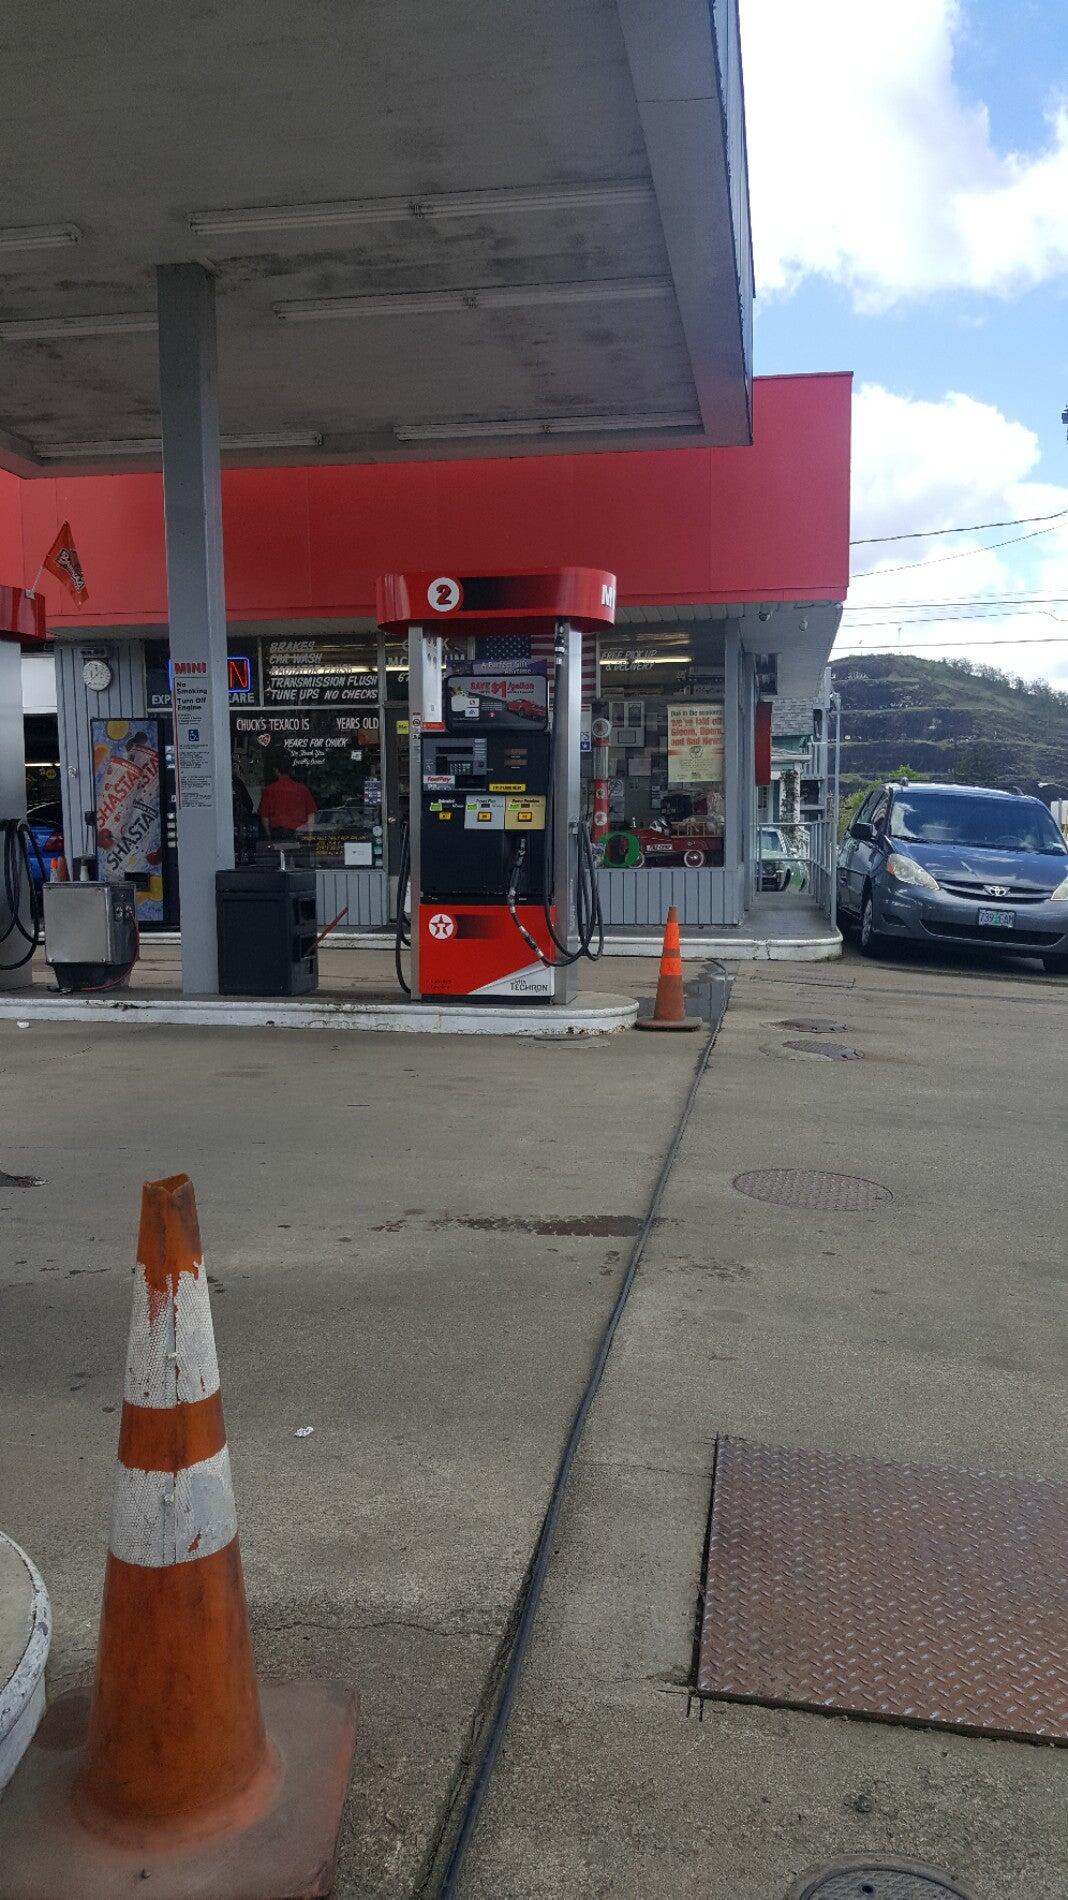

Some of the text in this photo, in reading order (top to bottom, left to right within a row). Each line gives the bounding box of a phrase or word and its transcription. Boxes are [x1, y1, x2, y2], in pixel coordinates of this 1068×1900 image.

[436, 585, 452, 605] 2
[270, 641, 316, 653] BRAKES
[293, 653, 323, 663] WASH
[174, 662, 206, 674] MINI
[271, 675, 378, 688] TRANSMISSION FLUSH
[271, 689, 378, 700] TUNE UPS NO CHECKS
[177, 704, 202, 712] Engine
[236, 717, 379, 731] CHUCK'S TEXACO IS YEARS OLD
[283, 738, 348, 748] YEARS FOR CHUCK
[97, 769, 141, 828] SHASTA
[106, 810, 157, 871] SHASTA
[510, 982, 548, 992] TECHRON
